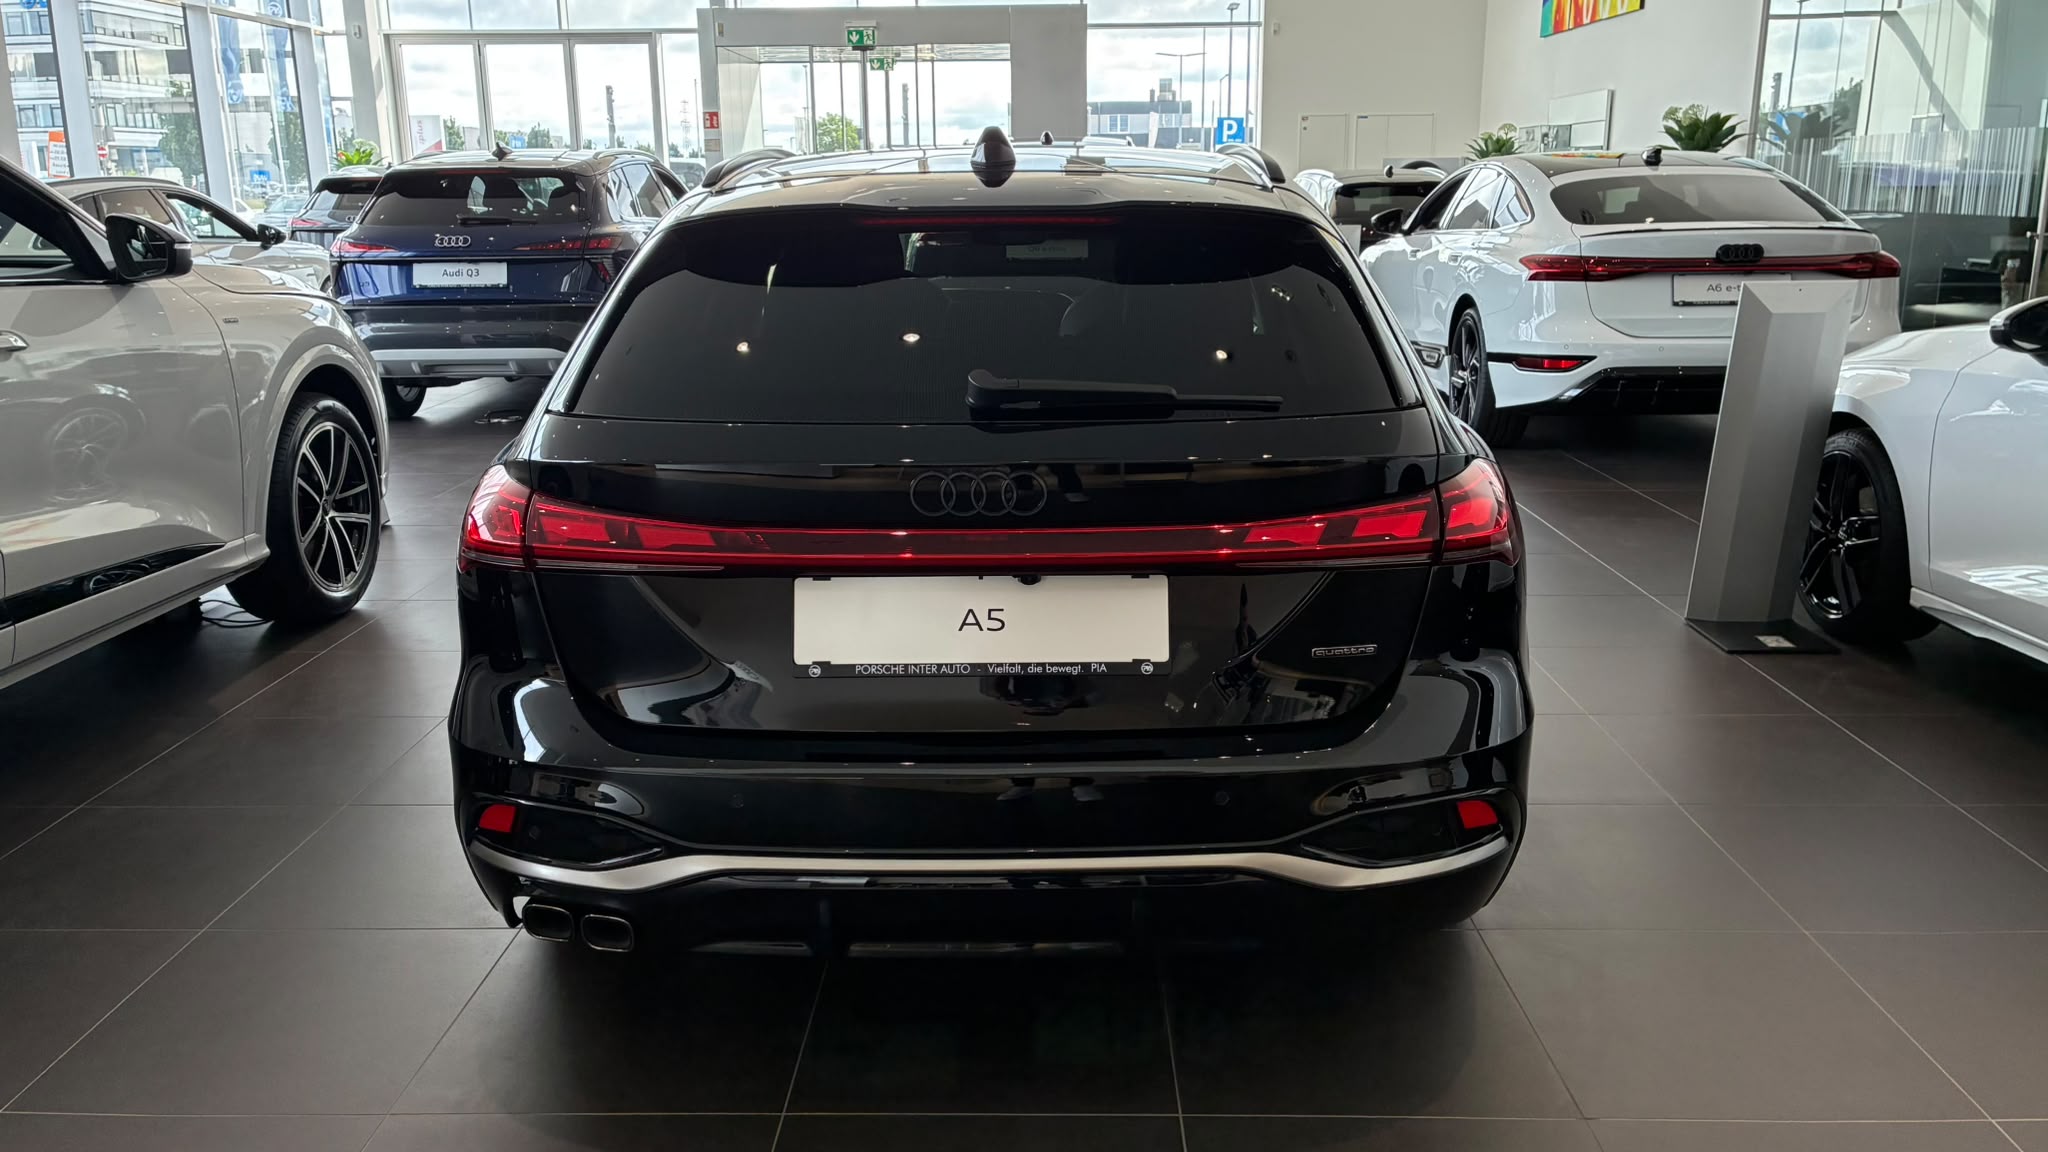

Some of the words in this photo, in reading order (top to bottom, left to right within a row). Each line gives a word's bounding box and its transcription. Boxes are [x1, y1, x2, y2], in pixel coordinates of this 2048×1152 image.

[1222, 119, 1238, 142] P
[442, 268, 464, 278] Audi
[466, 268, 480, 278] Q3
[1706, 283, 1723, 293] A6
[1725, 284, 1742, 292] e-t
[958, 608, 1006, 632] A5
[1315, 647, 1375, 657] quattro
[855, 664, 905, 675] PORSCHE
[908, 664, 938, 674] INTER
[940, 664, 971, 674] AUTO
[987, 663, 1024, 675] Vielfalt,
[1027, 663, 1043, 673] die
[1045, 663, 1084, 675] bewegt.
[1091, 663, 1108, 673] PIA
